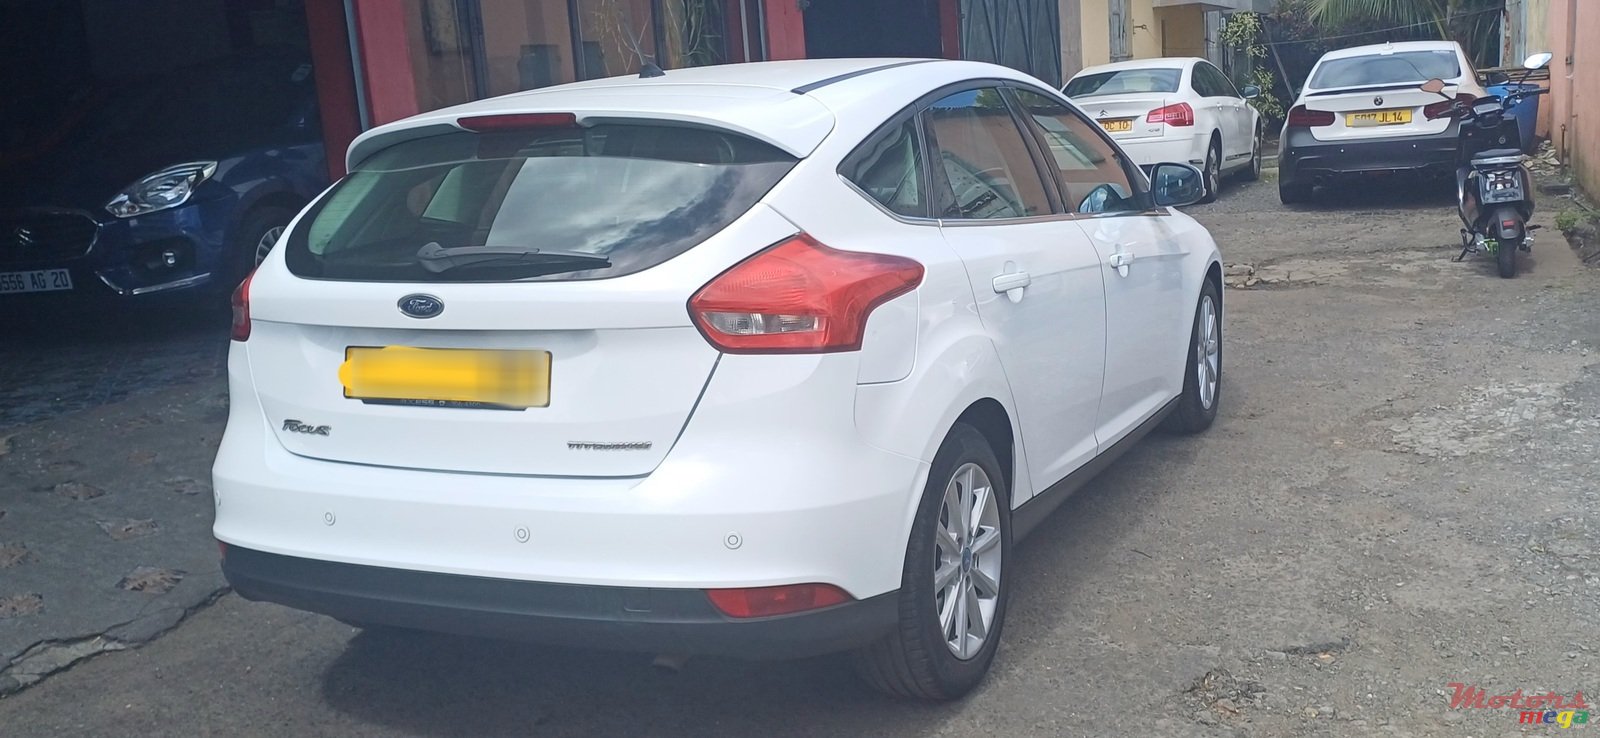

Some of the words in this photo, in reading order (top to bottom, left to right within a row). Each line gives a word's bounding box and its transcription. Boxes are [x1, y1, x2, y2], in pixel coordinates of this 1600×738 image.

[1379, 112, 1391, 123] JL
[1393, 111, 1403, 122] 14
[1119, 120, 1128, 129] 10
[30, 272, 46, 289] AG
[51, 271, 69, 288] 20
